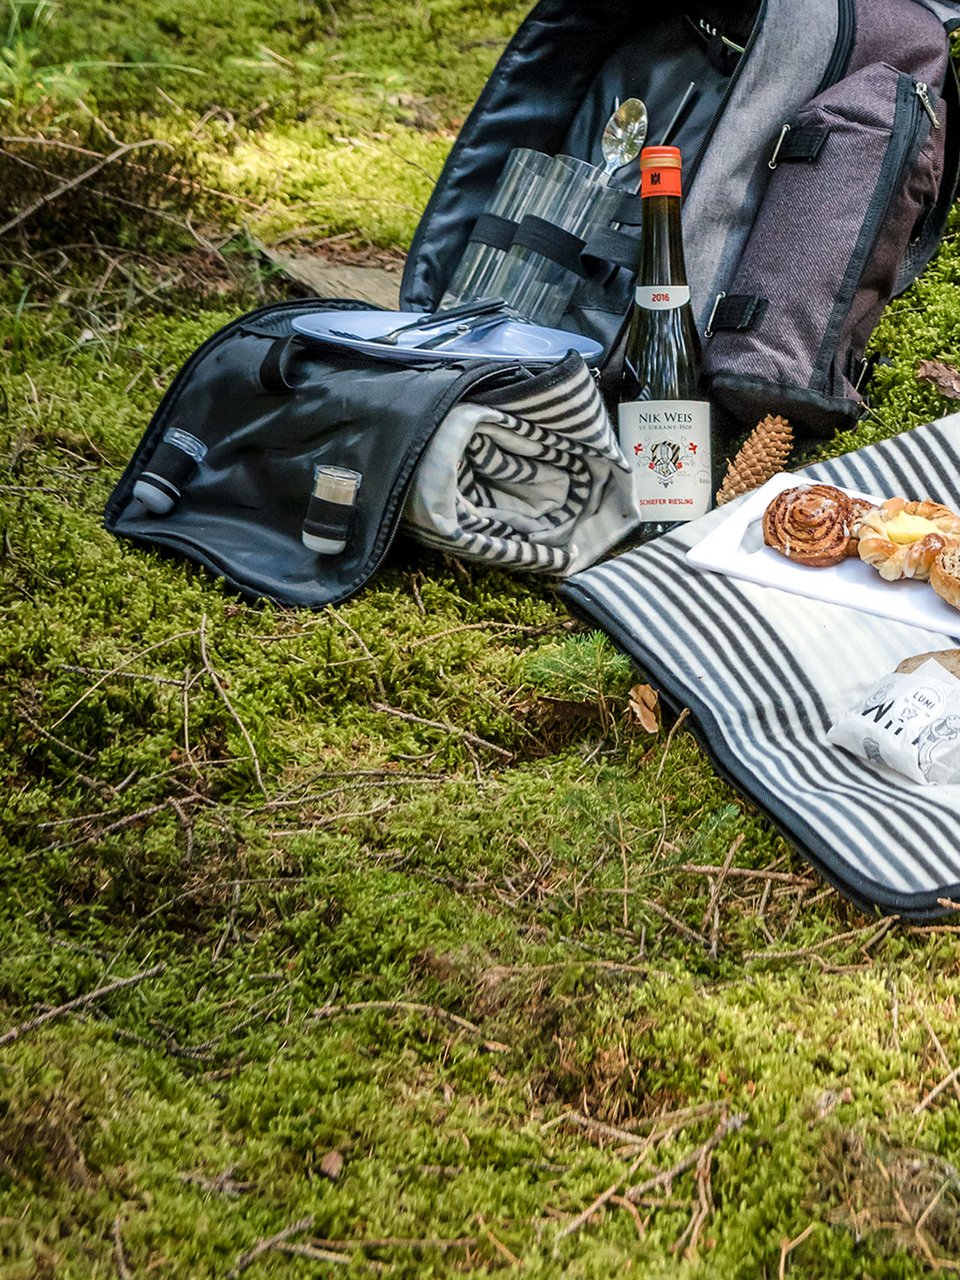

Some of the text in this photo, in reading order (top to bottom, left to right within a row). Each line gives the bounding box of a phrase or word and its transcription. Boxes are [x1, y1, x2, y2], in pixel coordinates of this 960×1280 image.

[651, 294, 670, 302] 2016
[639, 412, 693, 423] NIK WEIS
[640, 498, 667, 506] SCHIEFER
[913, 692, 936, 710] LUMI
